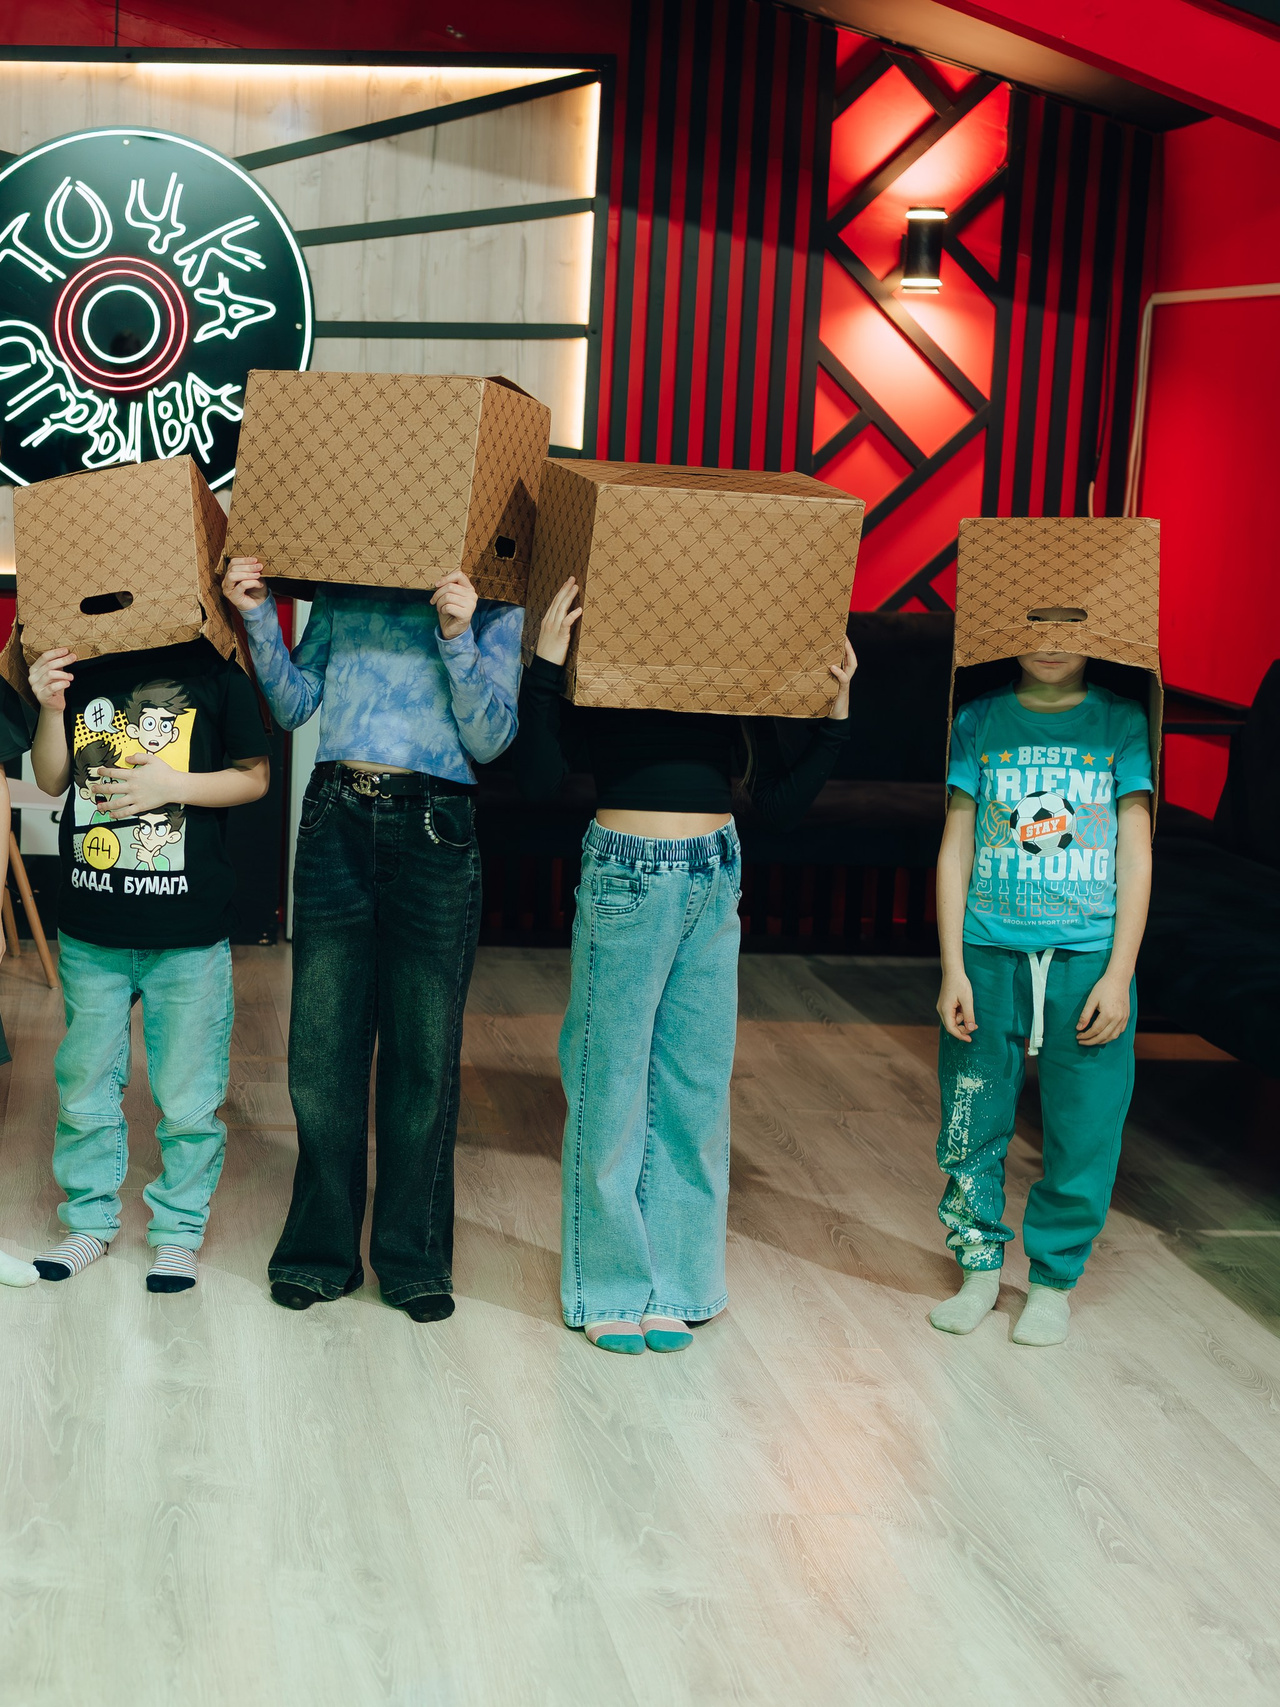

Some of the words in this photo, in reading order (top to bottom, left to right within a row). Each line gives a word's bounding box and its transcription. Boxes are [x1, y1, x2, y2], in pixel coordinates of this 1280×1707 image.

[1017, 745, 1078, 767] BEST
[1025, 818, 1061, 838] STAY
[977, 846, 1110, 881] STRONG
[71, 867, 114, 893] ВЛАД
[123, 875, 189, 896] БУМАГА
[1002, 918, 1037, 926] BROOKLYN
